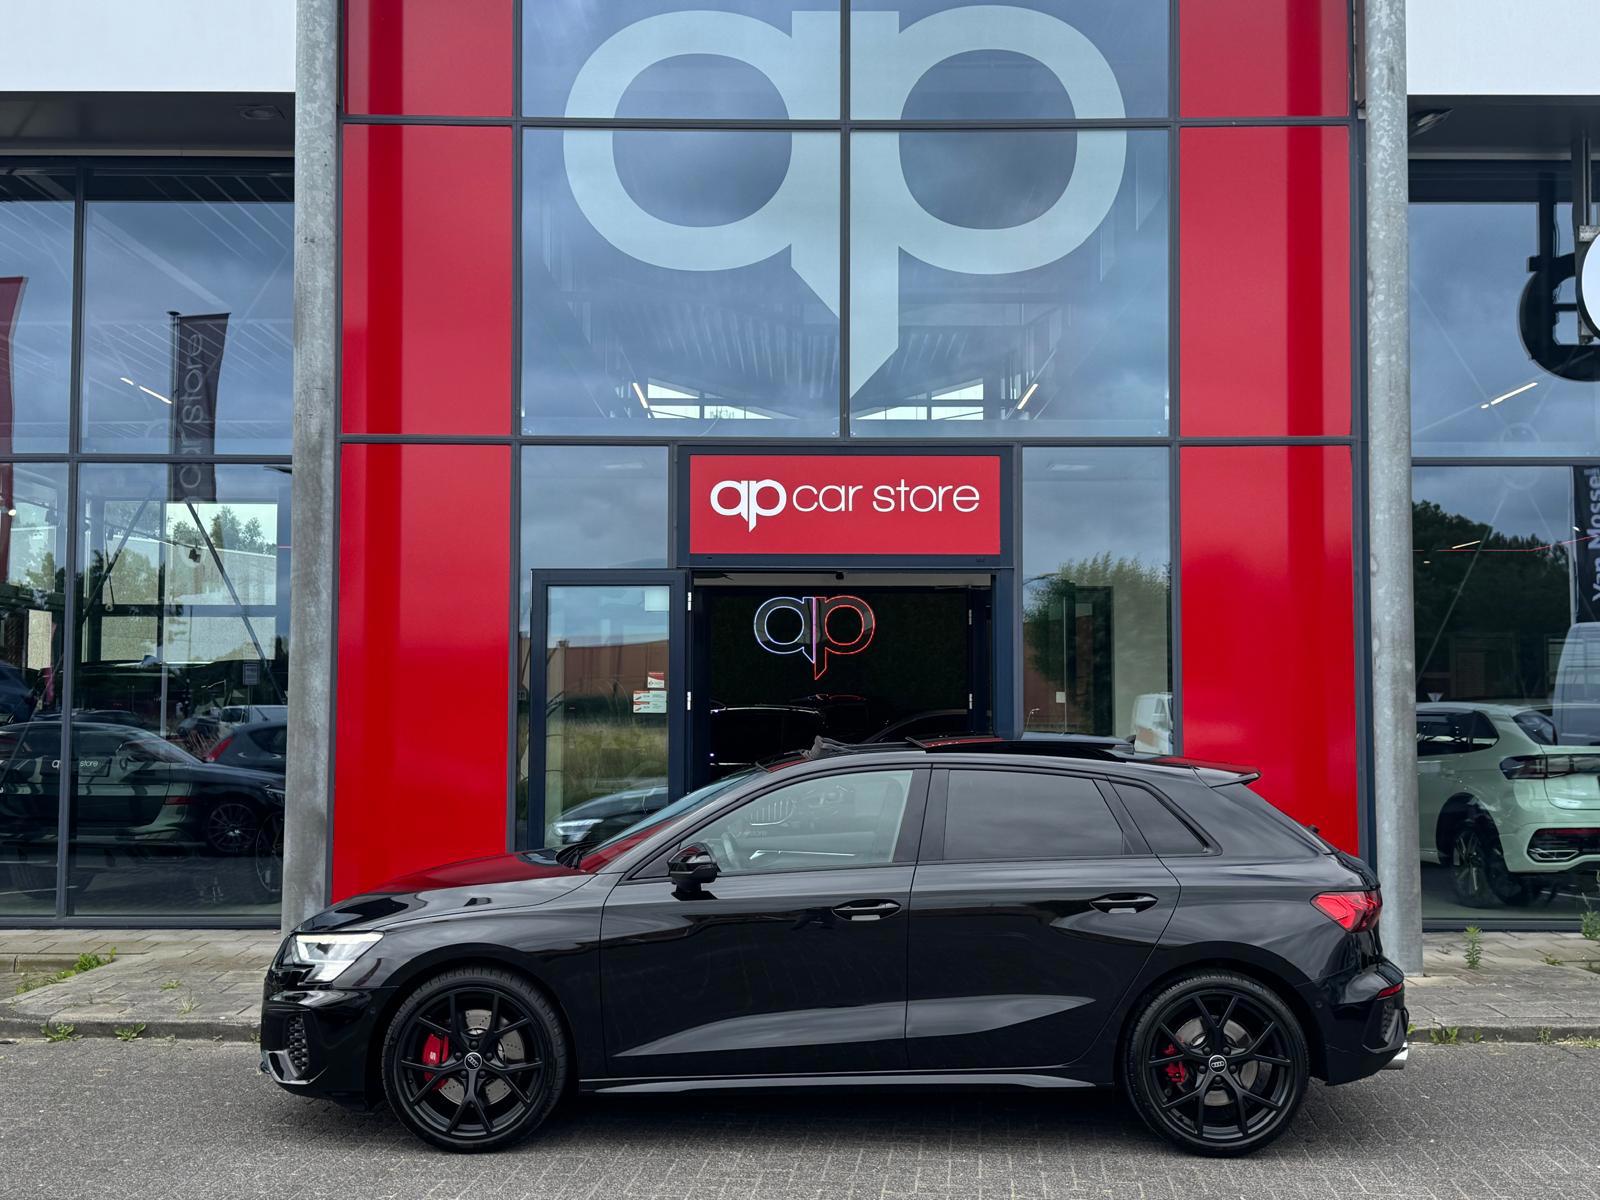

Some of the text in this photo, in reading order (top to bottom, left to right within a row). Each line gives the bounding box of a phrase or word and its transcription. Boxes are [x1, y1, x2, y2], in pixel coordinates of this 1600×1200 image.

[181, 333, 204, 423] store
[792, 485, 863, 513] car
[872, 479, 980, 513] store
